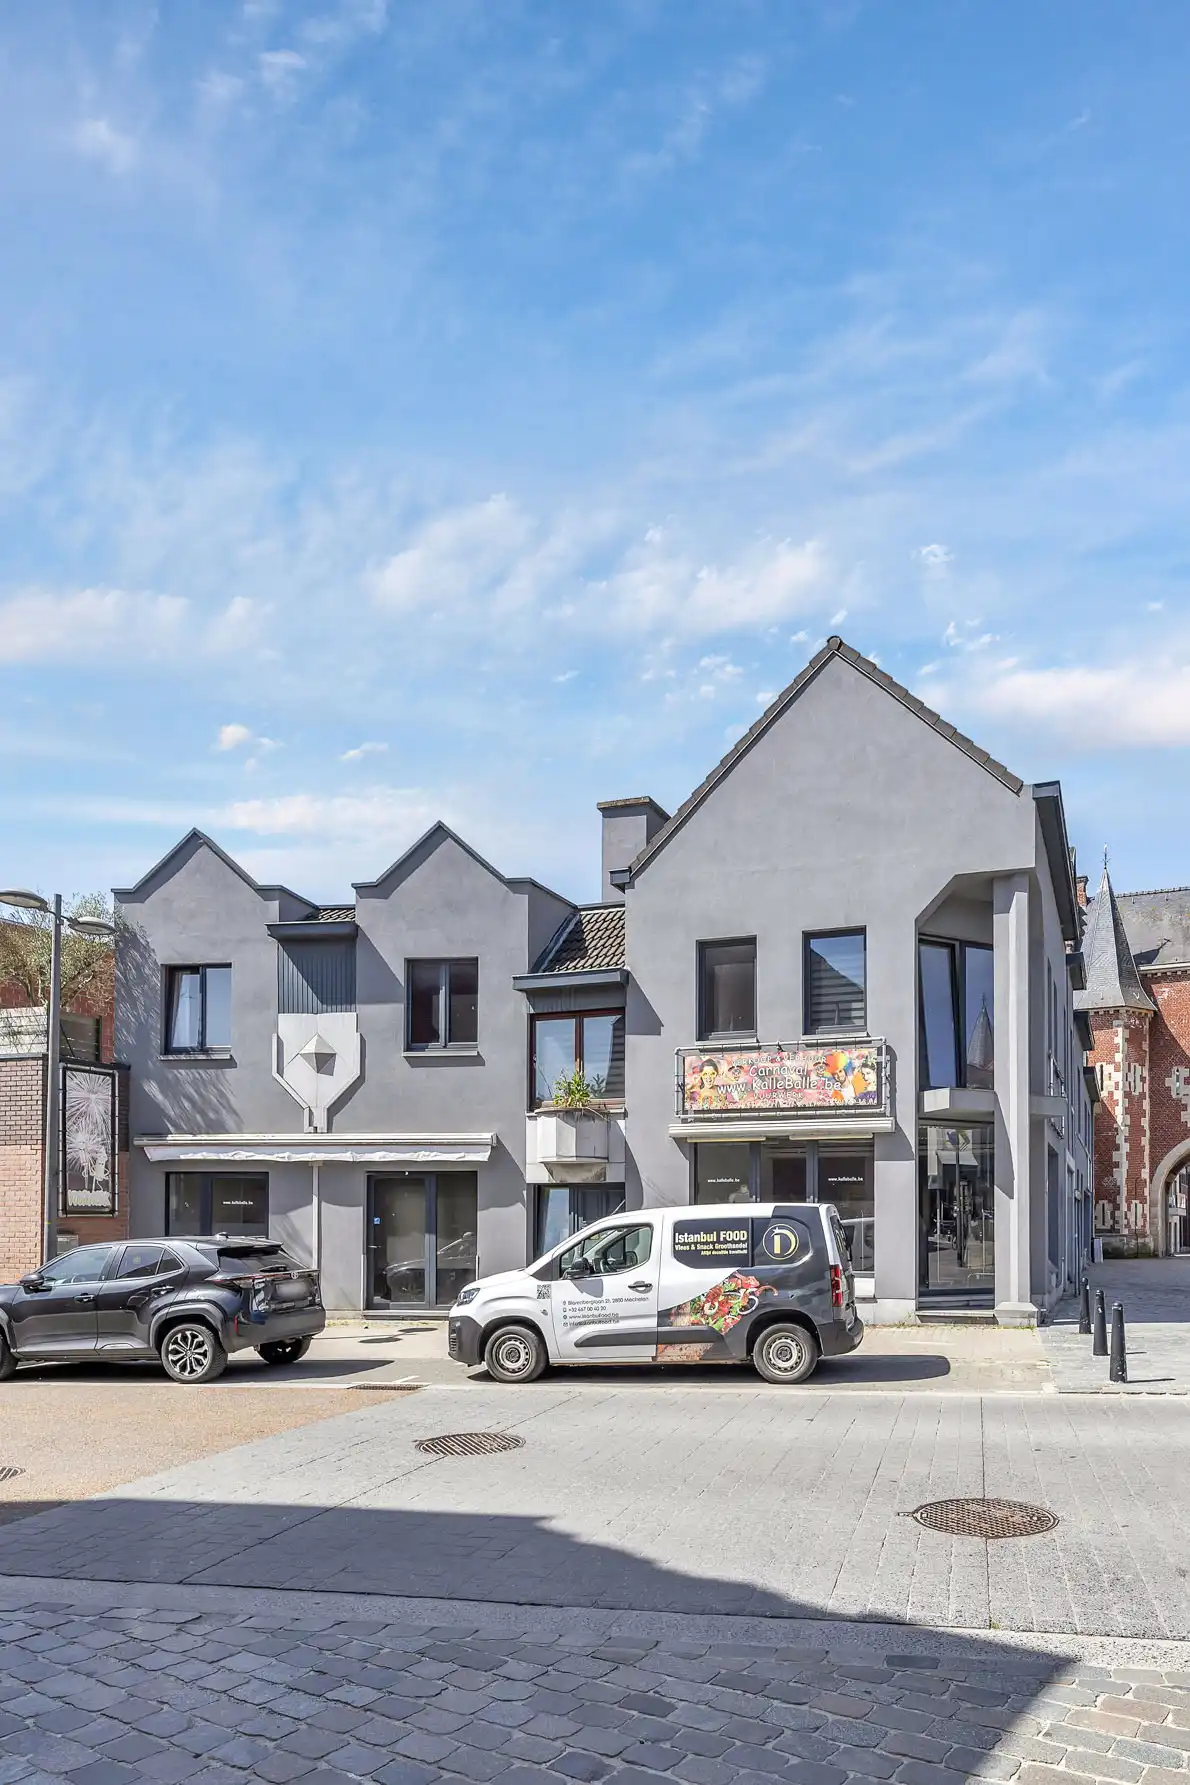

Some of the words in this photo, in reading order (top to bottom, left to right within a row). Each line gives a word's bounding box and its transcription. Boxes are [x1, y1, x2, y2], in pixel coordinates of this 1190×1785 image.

[749, 1065, 808, 1076] Carnaval
[753, 1091, 804, 1100] VUURWERK
[675, 1231, 717, 1243] Istanbul
[720, 1230, 748, 1242] FOOD
[675, 1243, 690, 1251] Vlees
[690, 1243, 696, 1251] &
